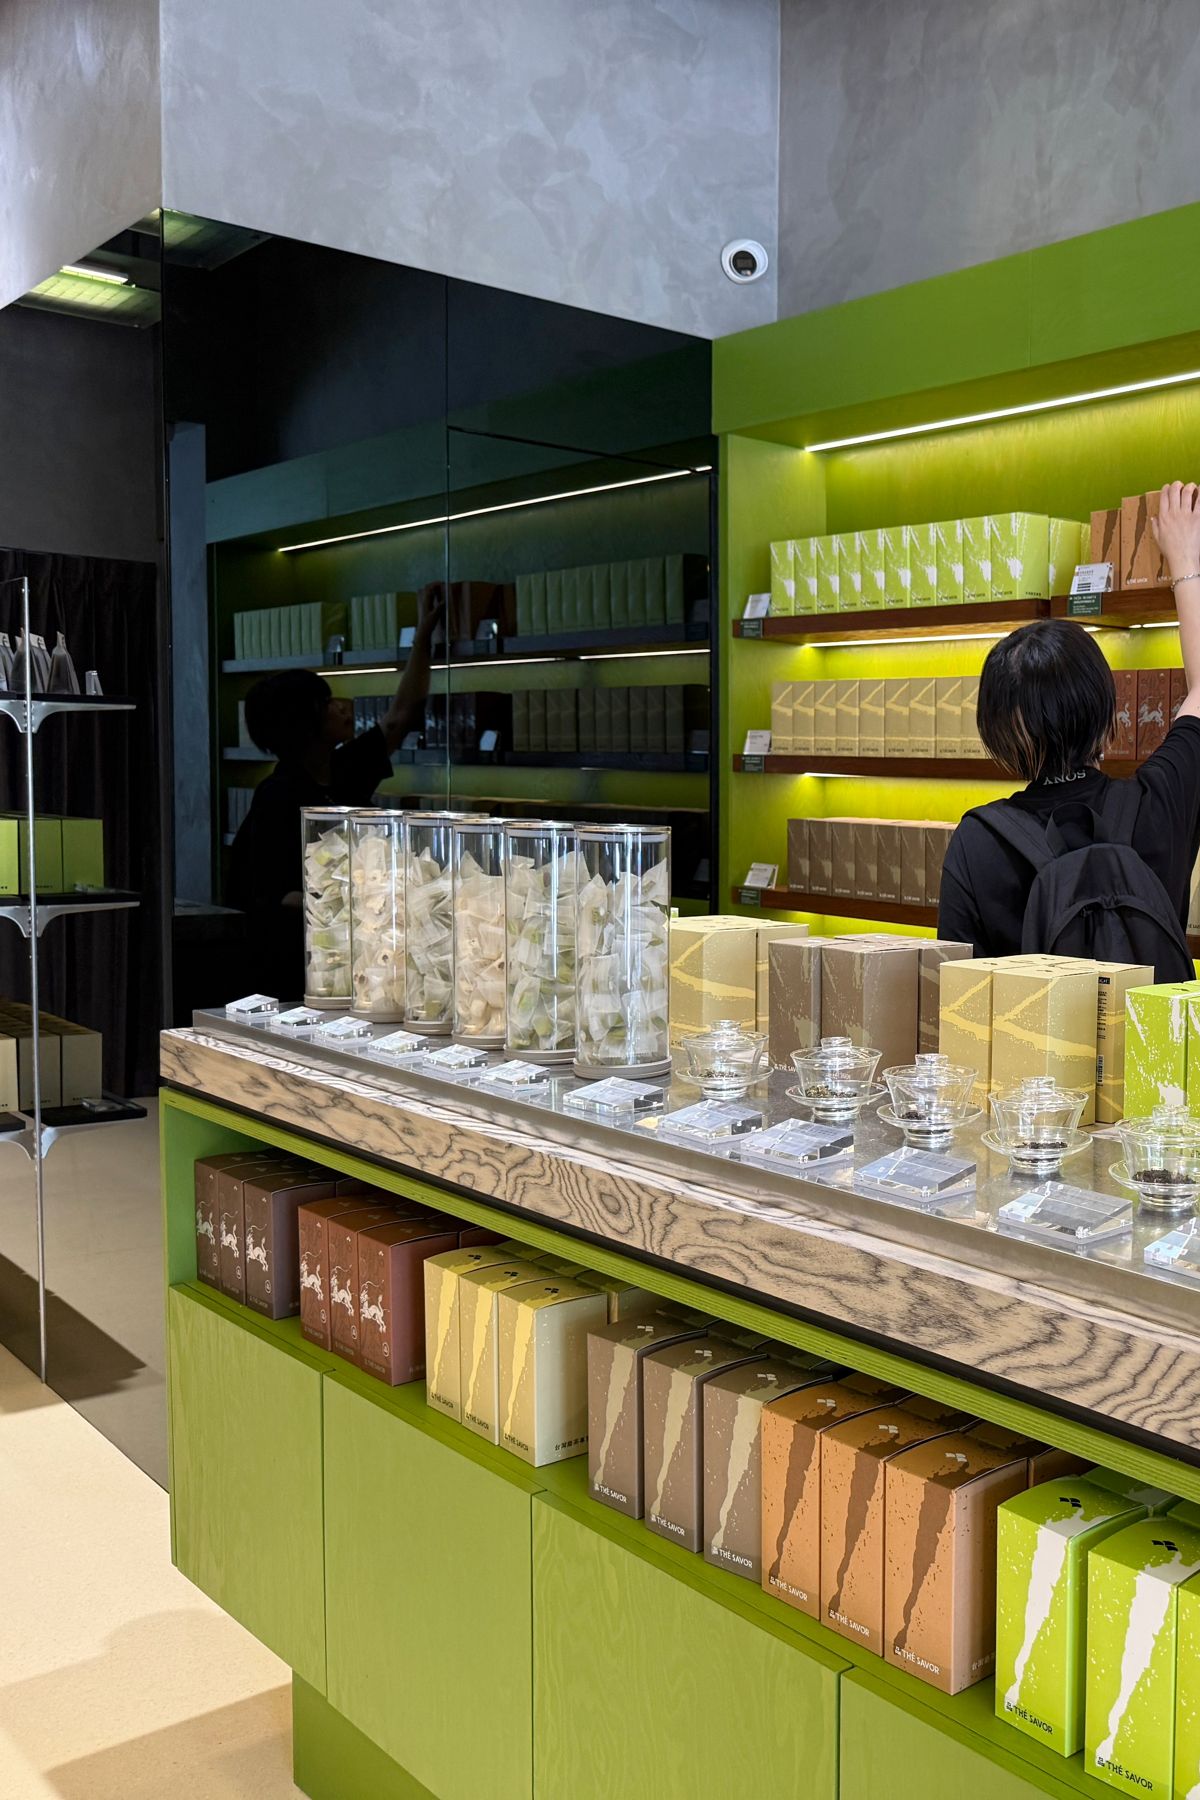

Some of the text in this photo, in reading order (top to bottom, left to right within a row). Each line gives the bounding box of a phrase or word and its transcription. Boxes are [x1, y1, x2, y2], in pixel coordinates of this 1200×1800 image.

[610, 1490, 627, 1503] SAVOR
[667, 1522, 685, 1536] SAVOR
[719, 1549, 752, 1568] THÉ SAVOR
[775, 1579, 808, 1601] THÉ SAVOR
[835, 1612, 869, 1637] THÉ SAVOR
[902, 1648, 940, 1675] THÉ SAVOR
[1013, 1705, 1053, 1734] THÉ SAVOR
[1106, 1760, 1153, 1791] THÉ SAVOR
